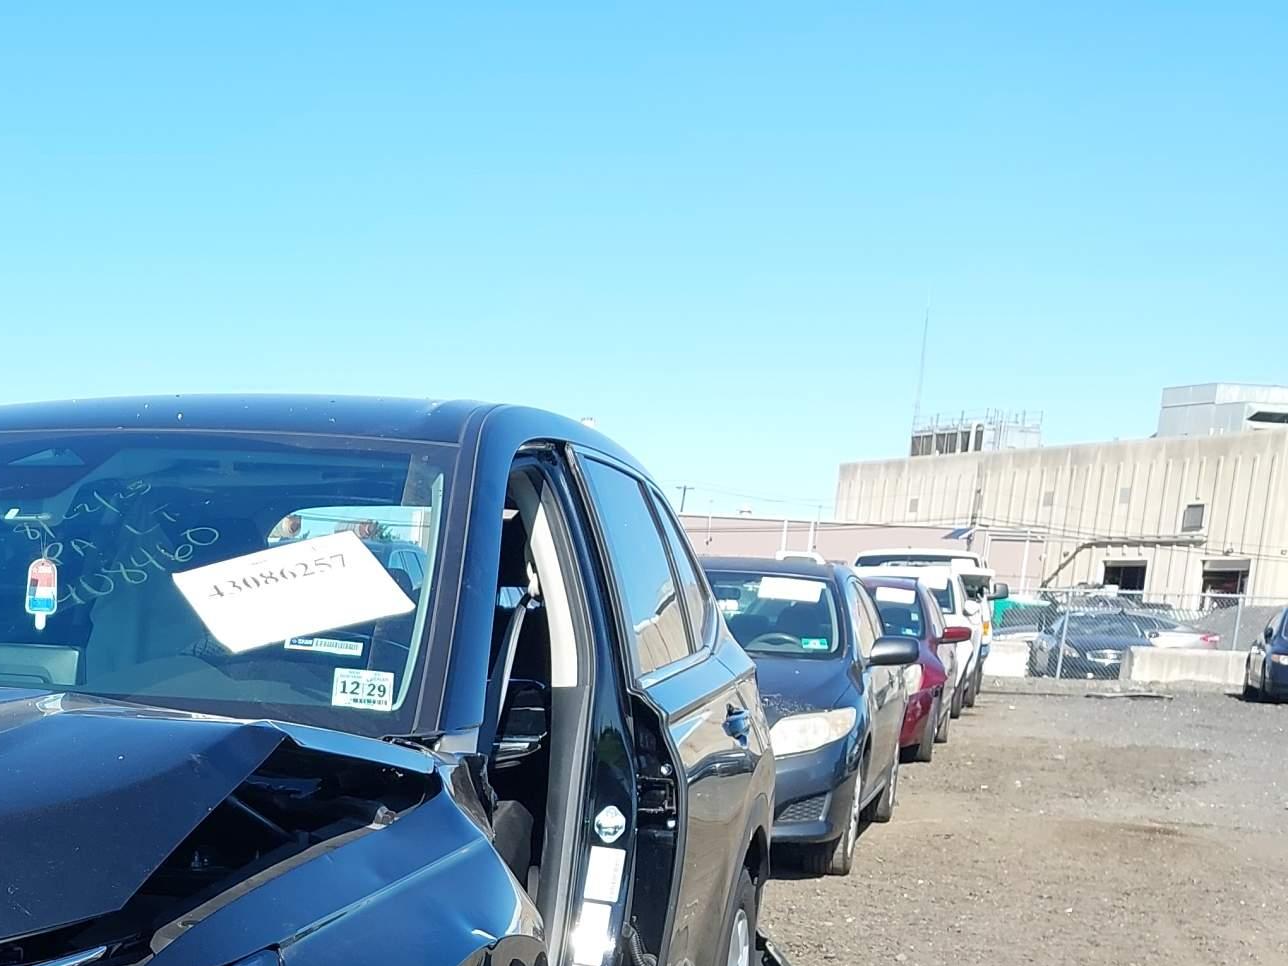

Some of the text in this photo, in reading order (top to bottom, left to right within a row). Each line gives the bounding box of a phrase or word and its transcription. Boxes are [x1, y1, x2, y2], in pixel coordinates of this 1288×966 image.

[208, 553, 347, 600] 43086257
[340, 679, 387, 698] 12 29
